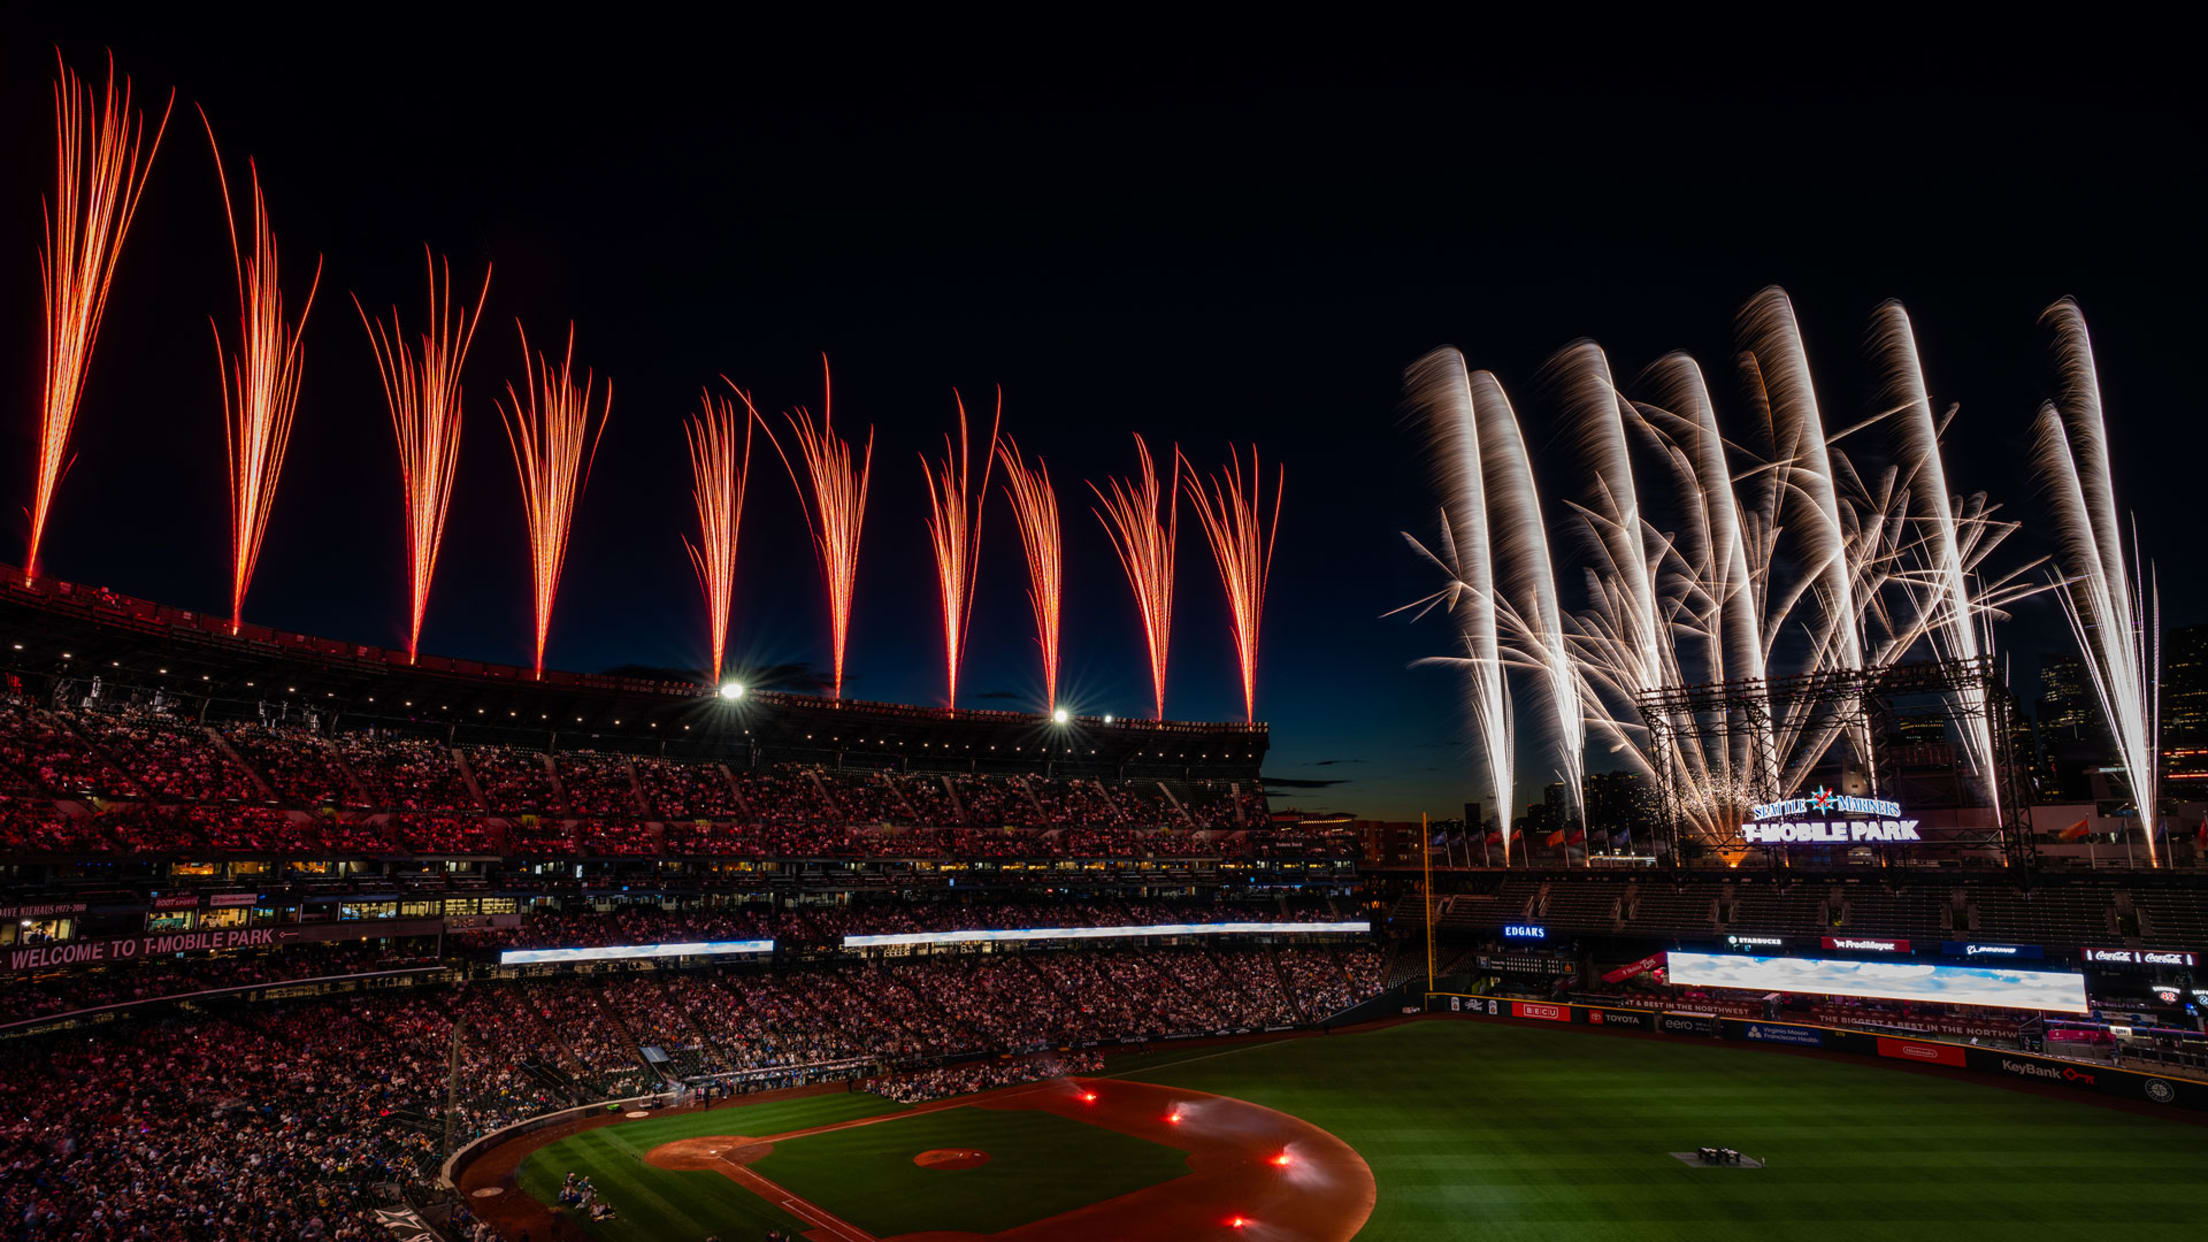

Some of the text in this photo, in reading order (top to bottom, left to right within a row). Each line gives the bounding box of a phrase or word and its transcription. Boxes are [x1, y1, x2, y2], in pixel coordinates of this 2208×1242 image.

[1754, 795, 1901, 820] SEATTLE MARINERS
[1850, 820, 1921, 841] PARK
[11, 928, 273, 971] WELCOME TO T-MOBILE PARK
[1524, 1005, 1557, 1018] BECU
[1605, 1013, 1640, 1026] TOYOTA
[1677, 1003, 1692, 1011] THE
[1694, 1004, 1751, 1016] NORTHWEST
[1665, 1019, 1693, 1031] eero
[1819, 1014, 1838, 1023] THE
[1841, 1015, 1884, 1027] BIGGEST
[1896, 1021, 1924, 1032] BEST
[1941, 1025, 1963, 1035] THE
[2002, 1058, 2062, 1080] KeyBank
